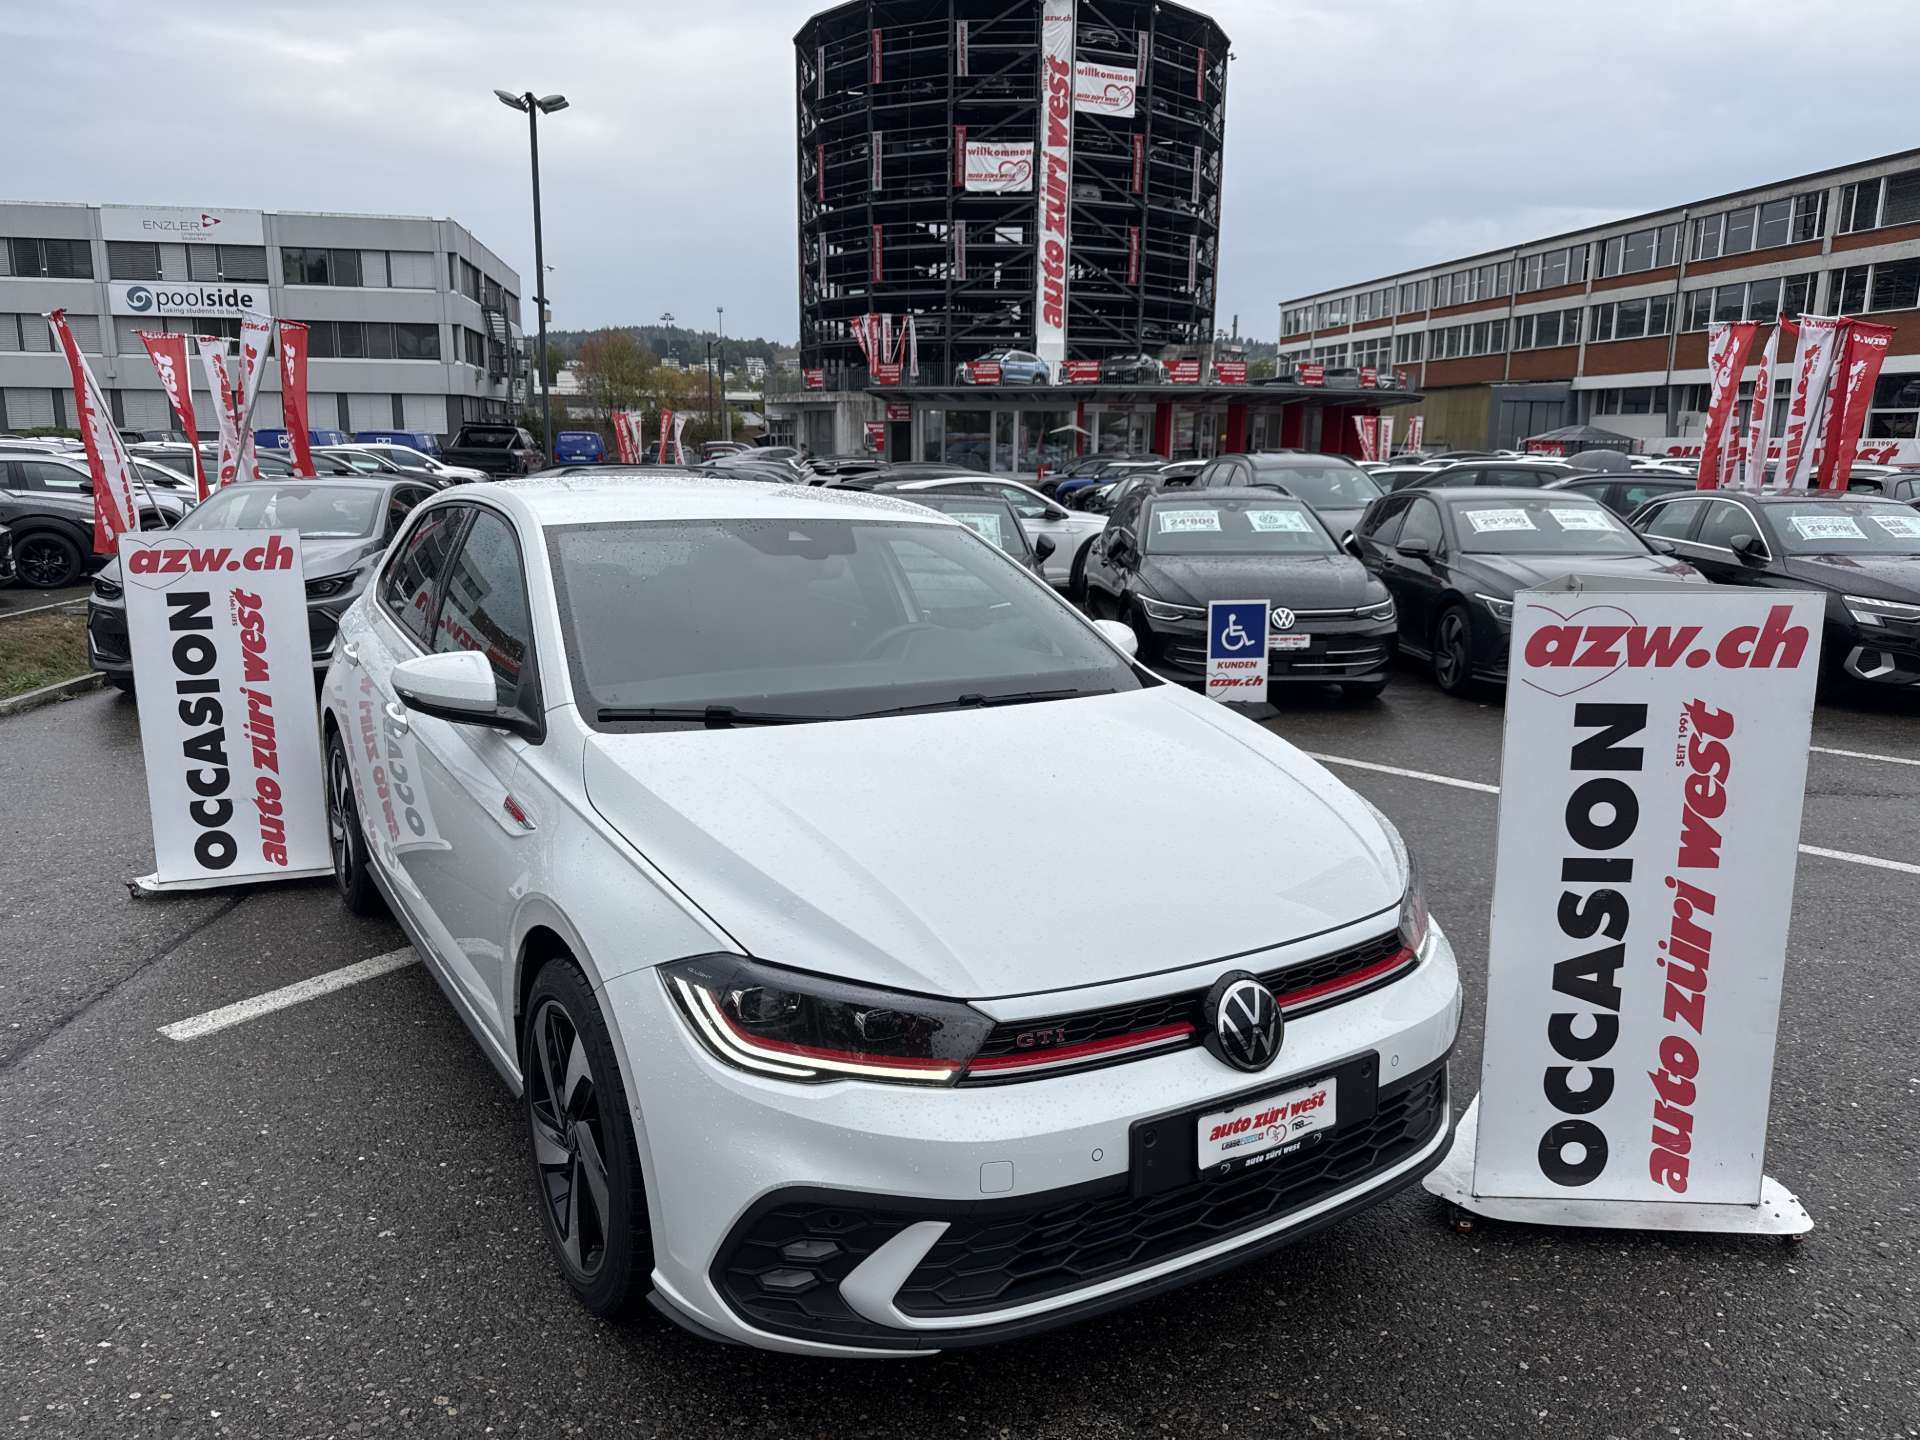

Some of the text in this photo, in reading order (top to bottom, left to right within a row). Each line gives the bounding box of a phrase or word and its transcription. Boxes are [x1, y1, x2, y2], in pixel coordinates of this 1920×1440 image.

[1076, 66, 1135, 82] willkommen
[967, 145, 1032, 157] willkommen
[1041, 54, 1070, 330] auto züri west
[142, 220, 200, 231] ENZLER
[156, 287, 253, 312] poolside
[186, 307, 216, 315] students
[129, 535, 295, 574] azw.ch
[1524, 604, 1810, 670] azw.ch
[1209, 675, 1264, 687] azw.ch
[1217, 661, 1257, 669] KUNDEN
[165, 591, 238, 870] OCCASION
[231, 587, 288, 867] auto züri west
[1675, 712, 1689, 768] SEIT 1991
[1537, 702, 1649, 1188] OCCASION
[1646, 697, 1735, 1195] auto züri west
[1016, 1028, 1065, 1048] GTI
[1209, 1089, 1327, 1142] auto züri west
[1245, 1154, 1264, 1167] auto
[1283, 1142, 1301, 1155] west
